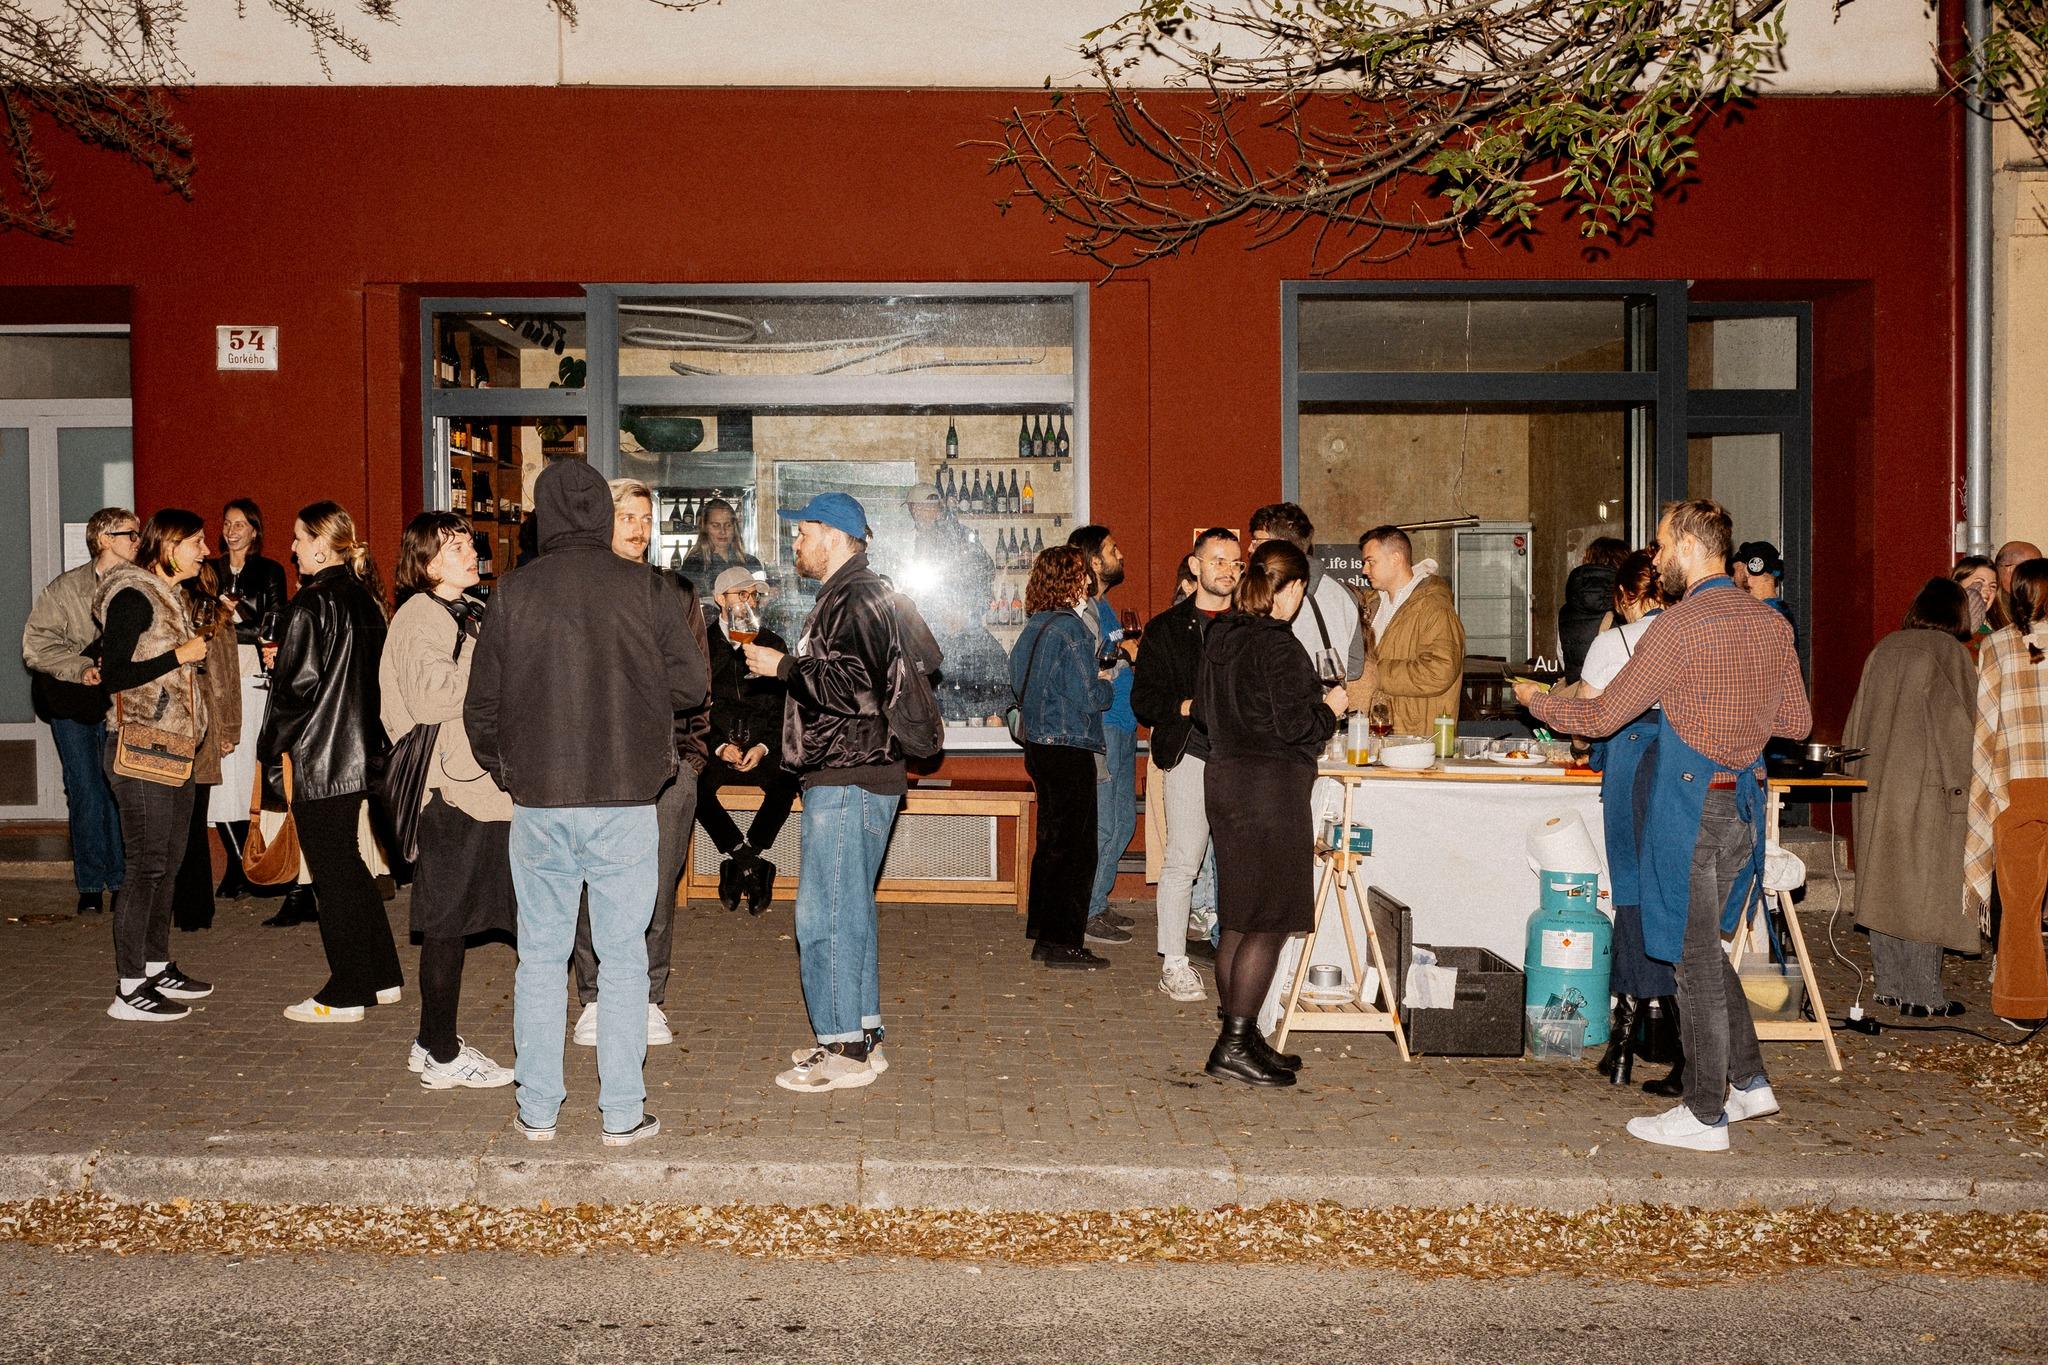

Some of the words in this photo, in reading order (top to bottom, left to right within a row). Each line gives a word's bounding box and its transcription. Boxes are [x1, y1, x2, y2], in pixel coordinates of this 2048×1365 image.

[230, 330, 265, 351] 54
[228, 353, 265, 364] Gorkého
[1350, 557, 1363, 569] is
[1533, 655, 1558, 672] Au
